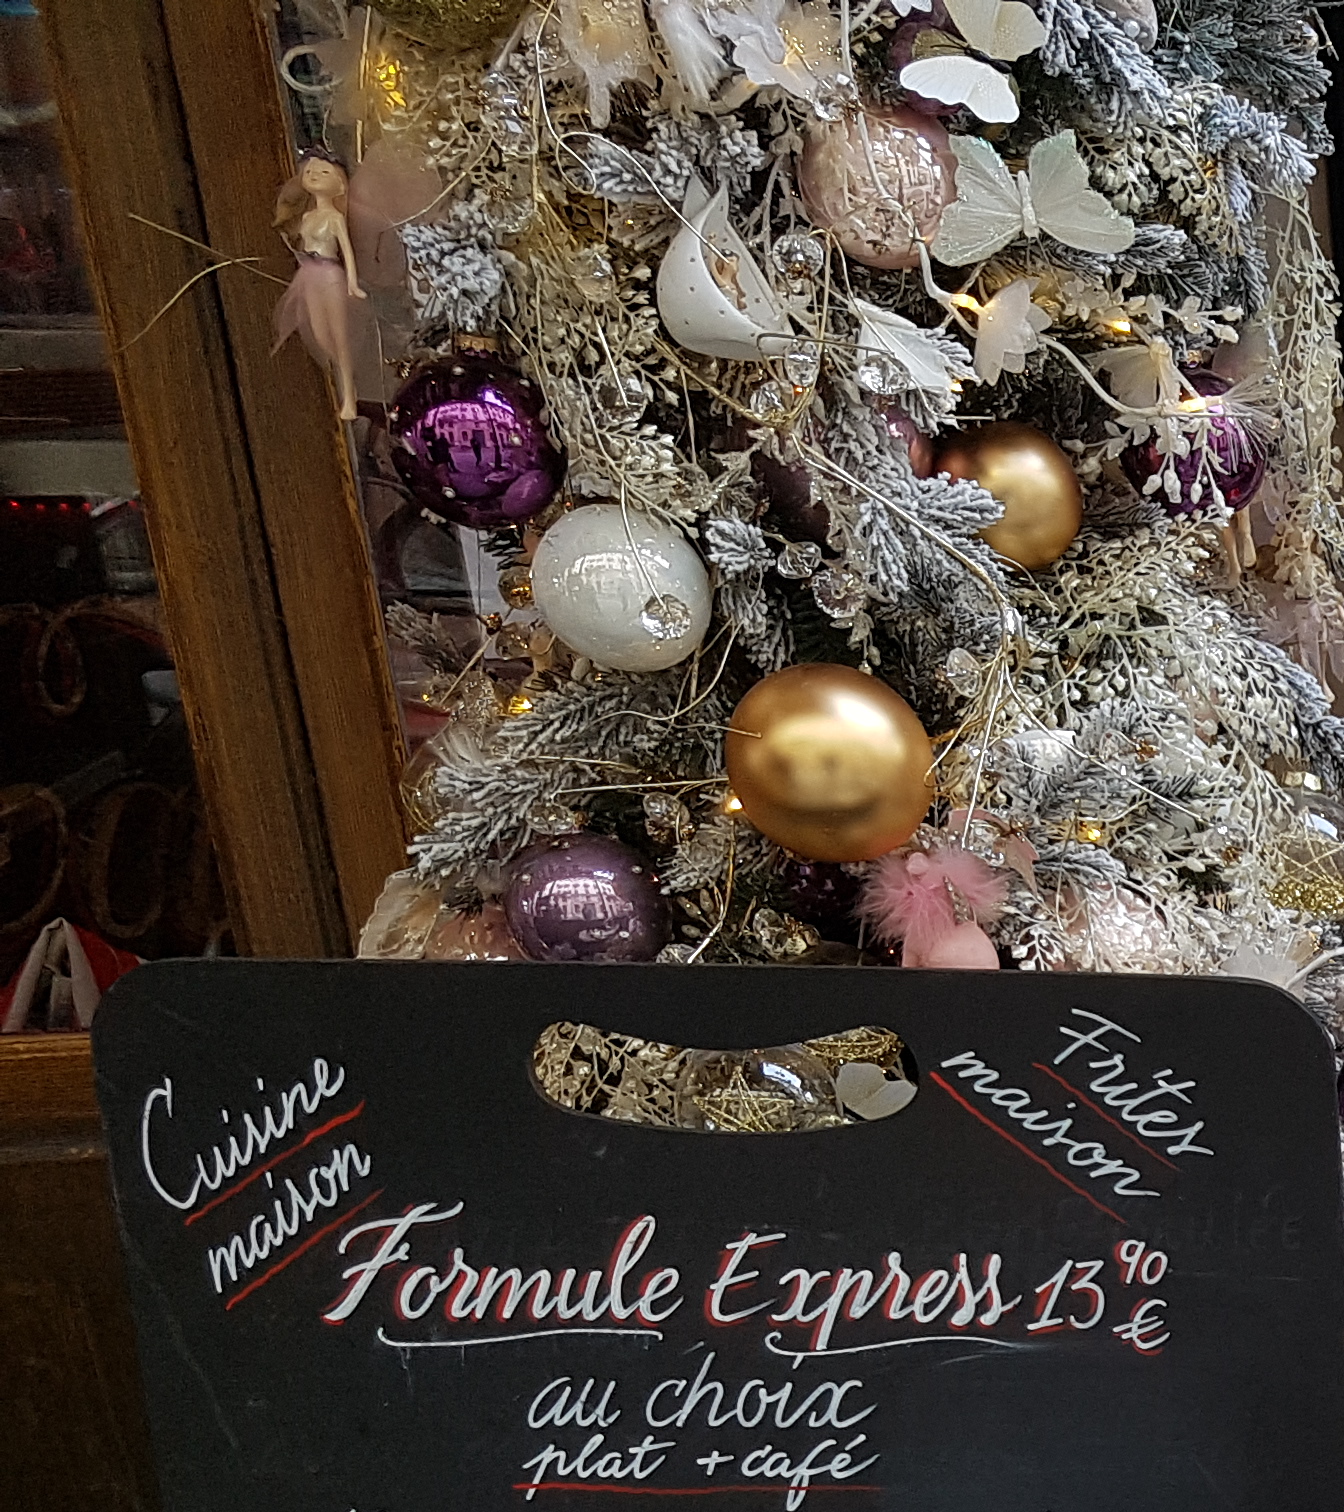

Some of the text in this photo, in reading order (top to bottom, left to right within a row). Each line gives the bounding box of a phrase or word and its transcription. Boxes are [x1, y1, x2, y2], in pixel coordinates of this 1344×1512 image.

[142, 1057, 344, 1209] Cuisine
[940, 1050, 1161, 1198] maison
[1053, 1007, 1214, 1157] Frites
[208, 1143, 370, 1293] maison
[322, 1201, 684, 1325] Formule
[704, 1232, 1021, 1352] Express
[528, 1351, 878, 1430] au choix
[523, 1436, 675, 1499] plat
